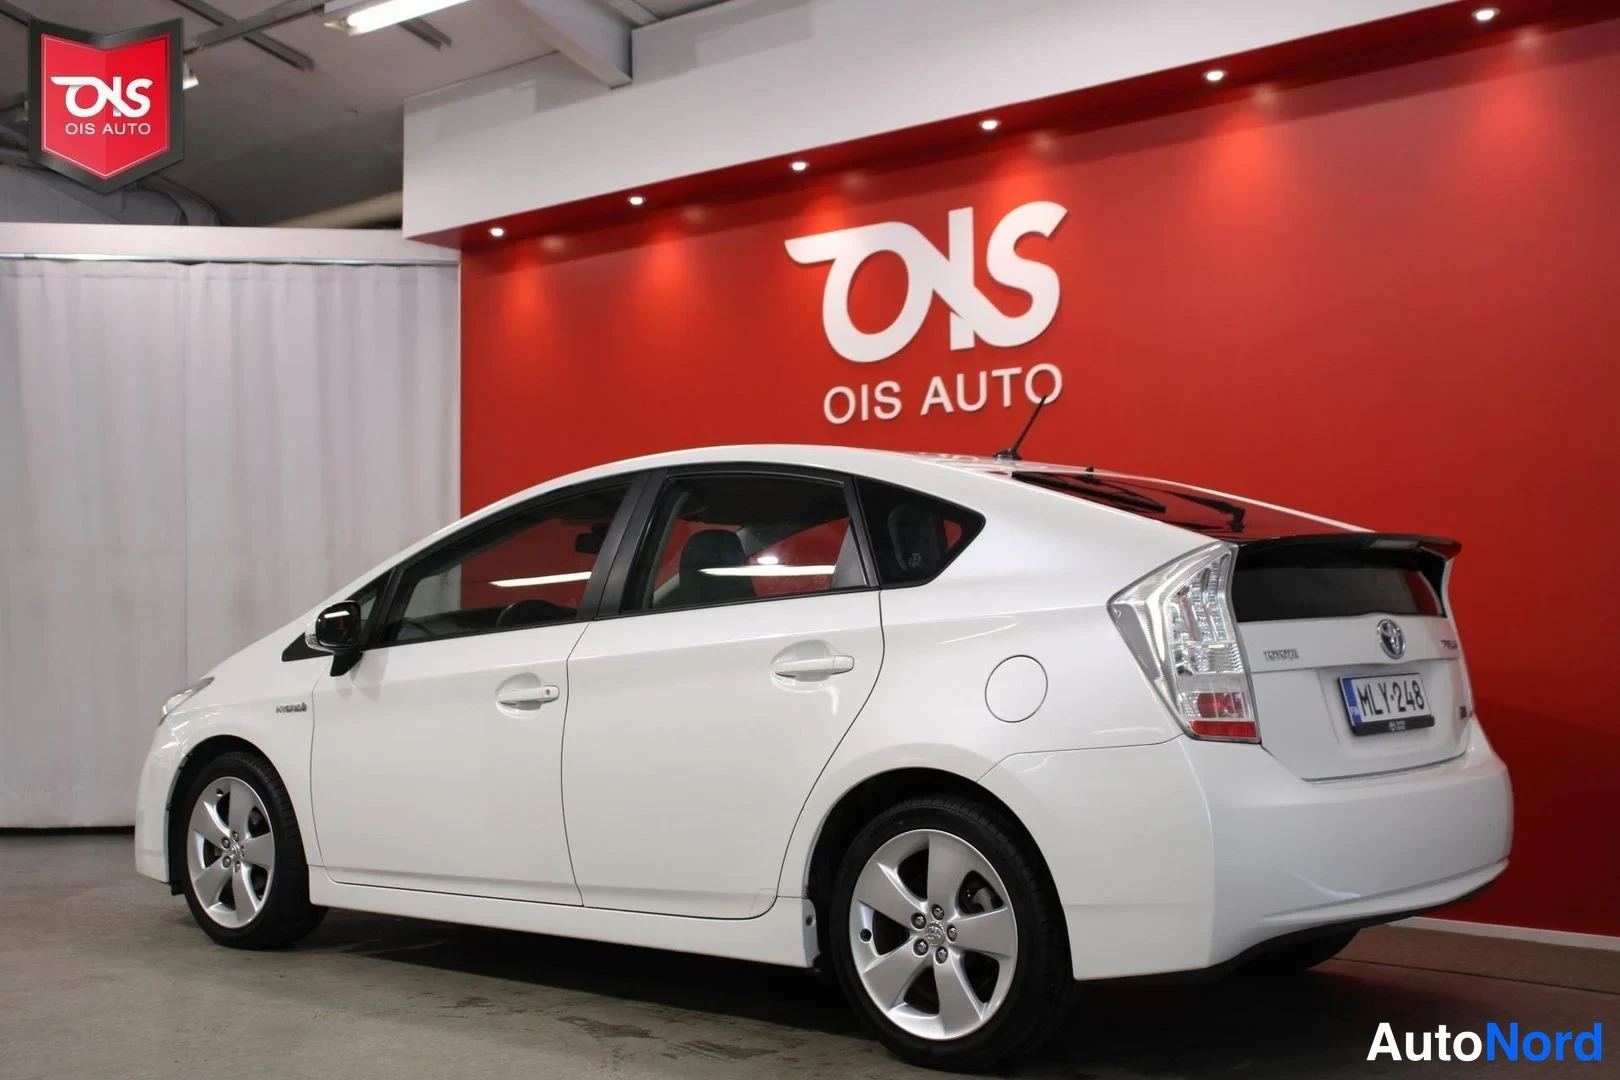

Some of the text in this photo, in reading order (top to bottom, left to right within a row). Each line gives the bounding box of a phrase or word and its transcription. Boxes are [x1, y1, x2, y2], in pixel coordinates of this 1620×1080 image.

[823, 363, 1063, 424] OIS AUTO
[1357, 680, 1424, 716] MLY-248
